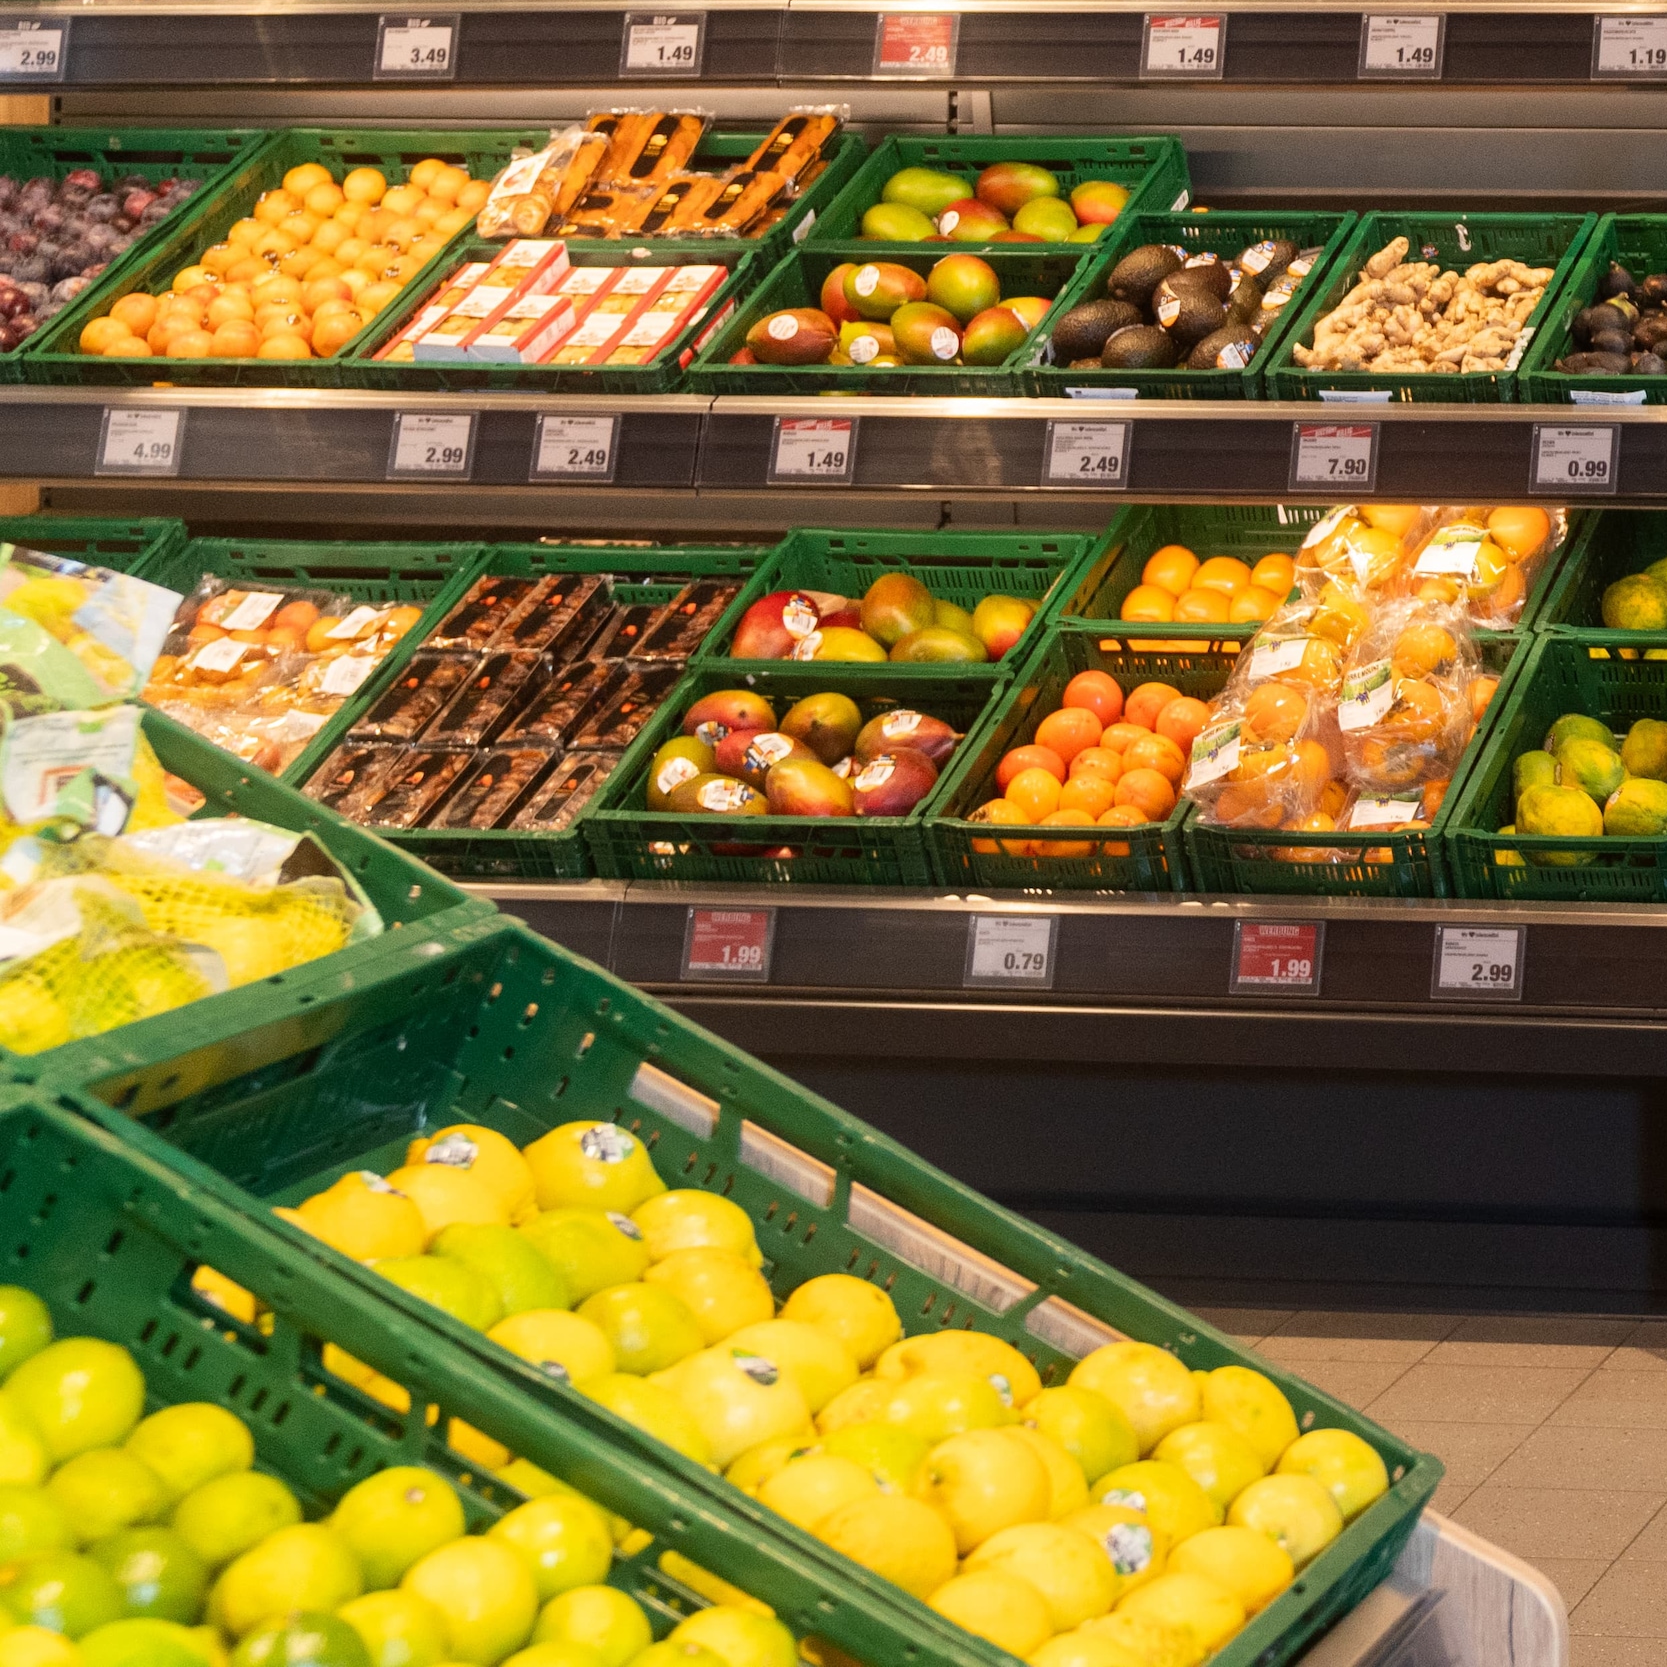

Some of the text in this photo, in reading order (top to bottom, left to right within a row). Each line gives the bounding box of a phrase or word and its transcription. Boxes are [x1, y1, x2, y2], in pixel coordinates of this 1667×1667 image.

[20, 51, 56, 66] 2.99
[411, 49, 446, 63] 3.49
[658, 46, 693, 60] 1.49
[910, 46, 948, 62] 2.49
[1178, 48, 1214, 63] 1.49
[1397, 47, 1433, 63] 1.49
[1629, 49, 1666, 64] 1.19
[133, 443, 171, 459] 4.99
[426, 447, 463, 463] 2.99
[568, 449, 606, 465] 2.49
[807, 452, 844, 468] 1.49
[1080, 456, 1118, 472] 2.49
[1328, 458, 1366, 475] 7.90
[1568, 460, 1607, 477] 0.99
[1258, 925, 1300, 937] WERBUNG
[722, 945, 762, 964] 1.99
[1004, 953, 1044, 971] 0.79
[1271, 959, 1311, 978] 1.99
[1471, 964, 1512, 982] 2.99
